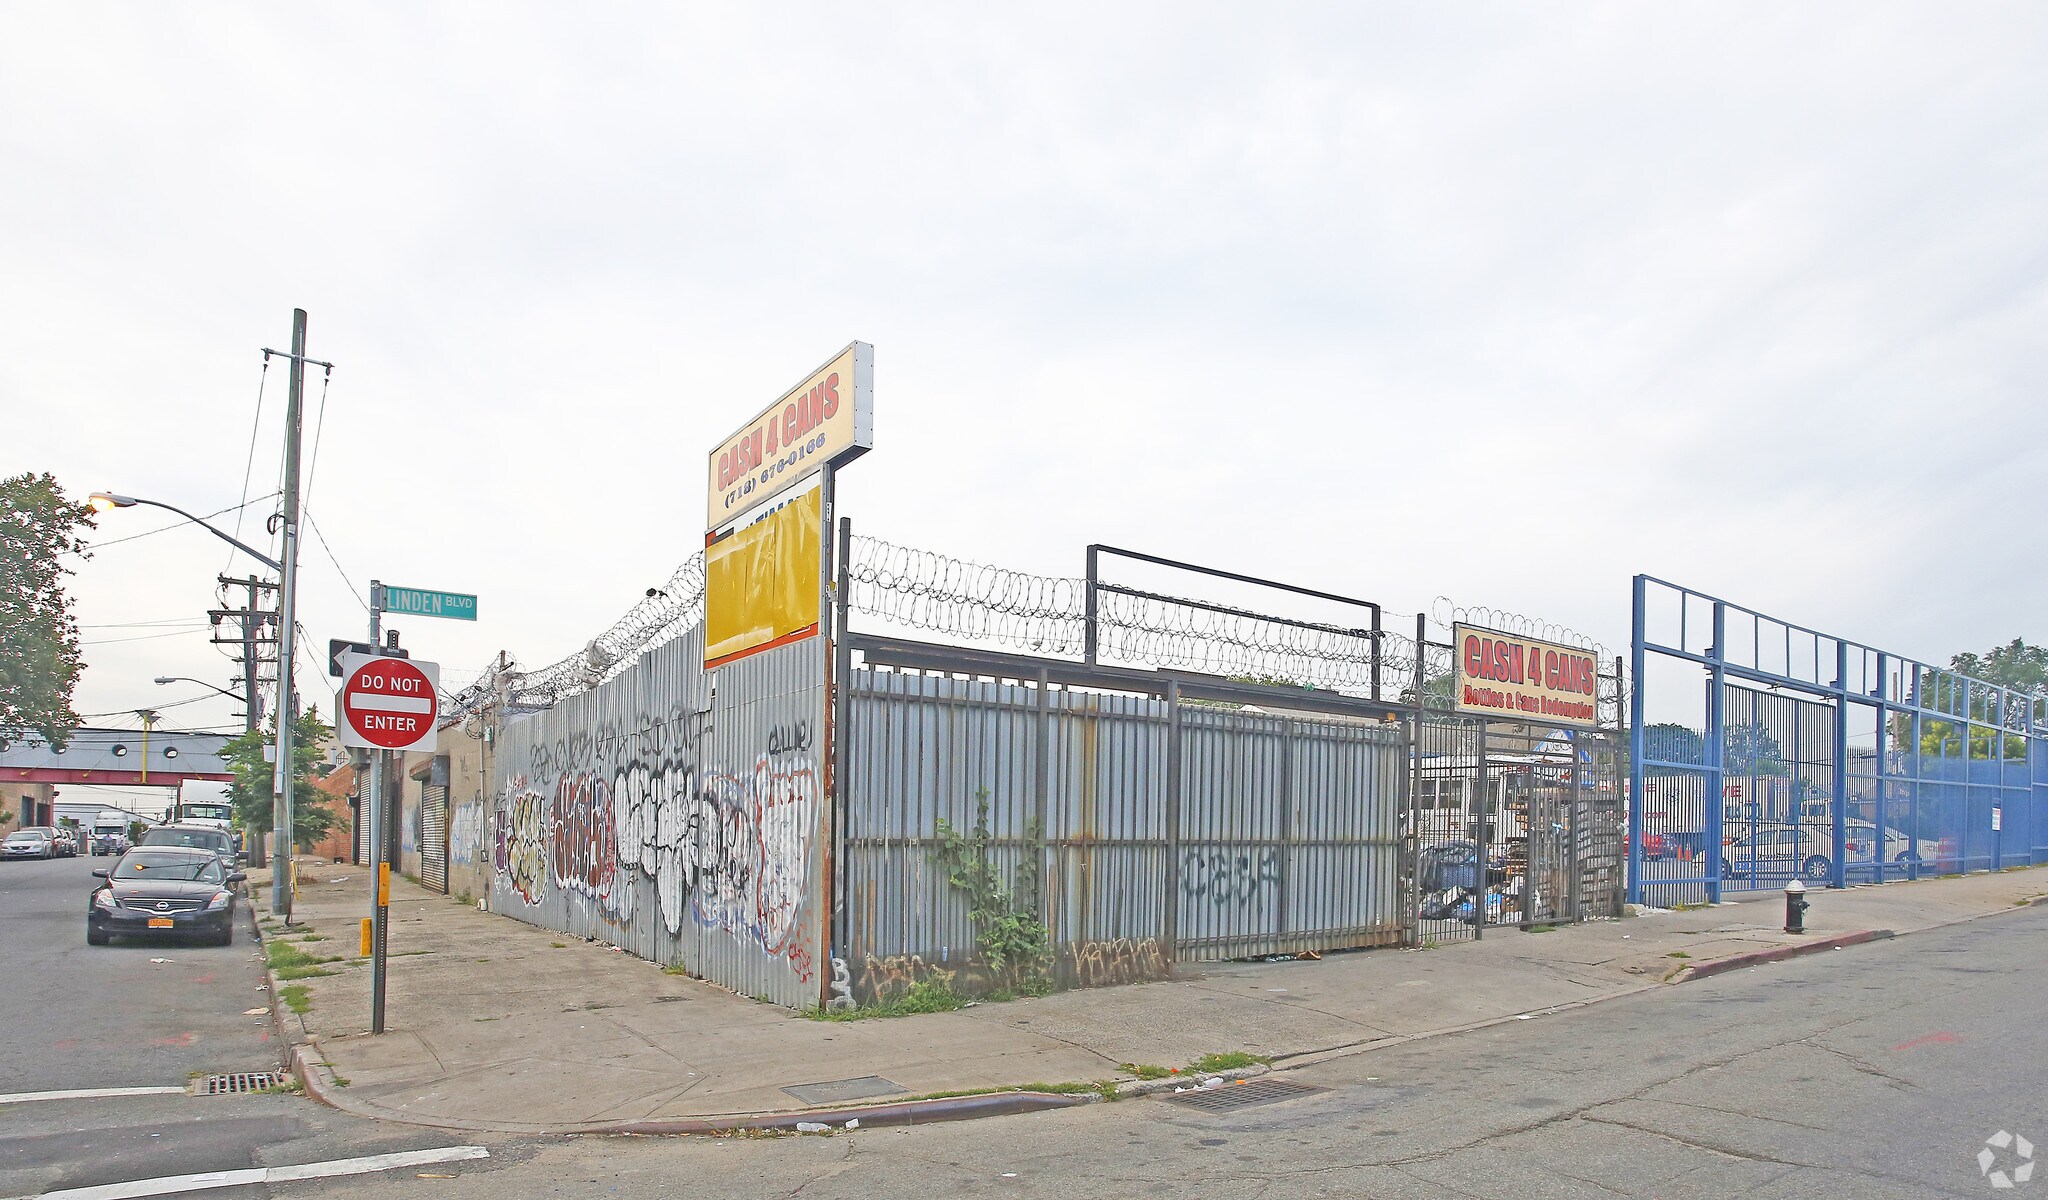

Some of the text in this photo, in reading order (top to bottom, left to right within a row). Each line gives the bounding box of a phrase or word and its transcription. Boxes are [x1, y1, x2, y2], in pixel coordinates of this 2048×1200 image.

[717, 372, 839, 492] CASH 4 CANS
[724, 432, 826, 509] (718) 676-0166
[387, 588, 473, 614] LINDEN BLVD
[1464, 634, 1594, 696] CASH 4 CANS
[361, 674, 421, 693] DO NOT
[1464, 684, 1594, 720] Bottles & Cans Redemption
[364, 715, 416, 732] ENTER
